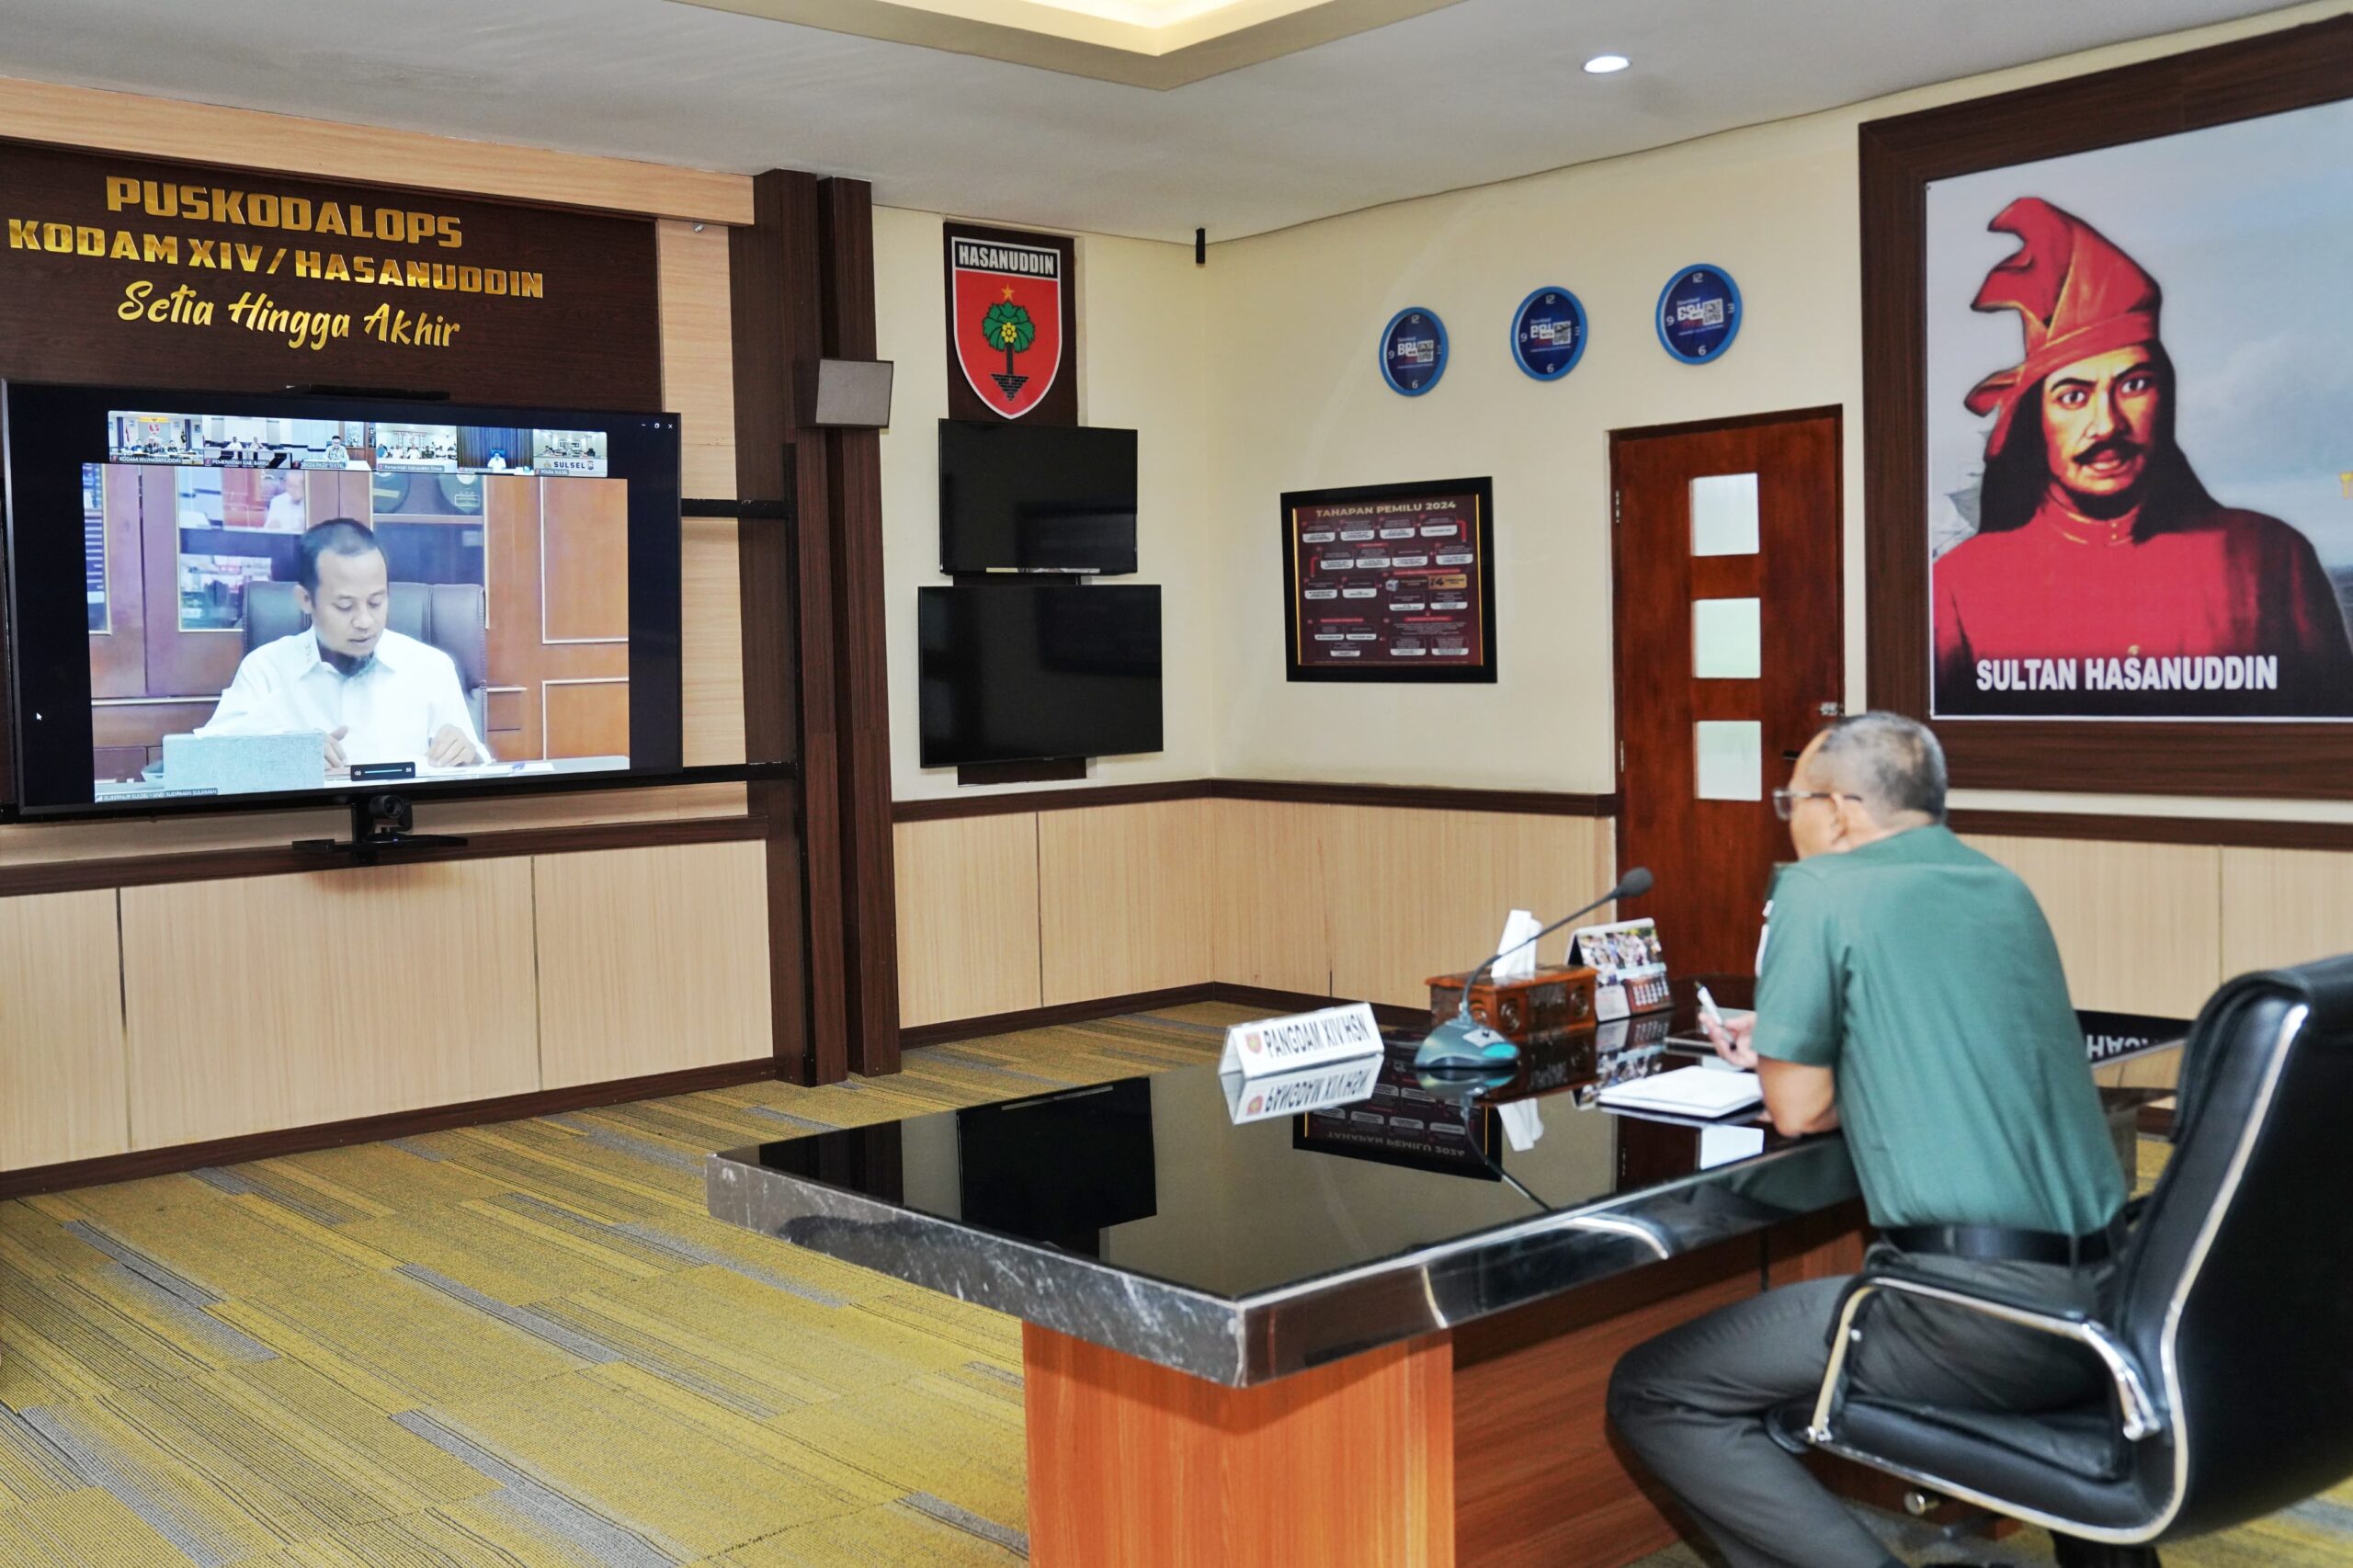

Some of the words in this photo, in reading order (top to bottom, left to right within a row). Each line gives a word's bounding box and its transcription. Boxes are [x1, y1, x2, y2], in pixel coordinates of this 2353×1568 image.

[106, 176, 462, 248] PUSKODALOPS
[9, 219, 177, 265] KODAM
[296, 249, 543, 299] HASANUDDIN
[959, 244, 1054, 276] HASANUDDIN
[117, 281, 213, 326] Setia
[228, 291, 349, 350] Hingga
[364, 303, 460, 347] Akhir
[1547, 363, 1554, 373] 6
[1698, 346, 1707, 356] 6
[1412, 380, 1418, 389] 6
[1316, 506, 1373, 517] TAHAPAN
[1377, 503, 1422, 514] PEMILU
[1426, 500, 1456, 510] 2024
[1976, 658, 2075, 691] SULTAN
[2086, 655, 2278, 690] HASANUDDIN
[1264, 1023, 1321, 1059] PANGDAM
[1320, 1017, 1345, 1048] XIV
[1345, 1013, 1371, 1043] HSN
